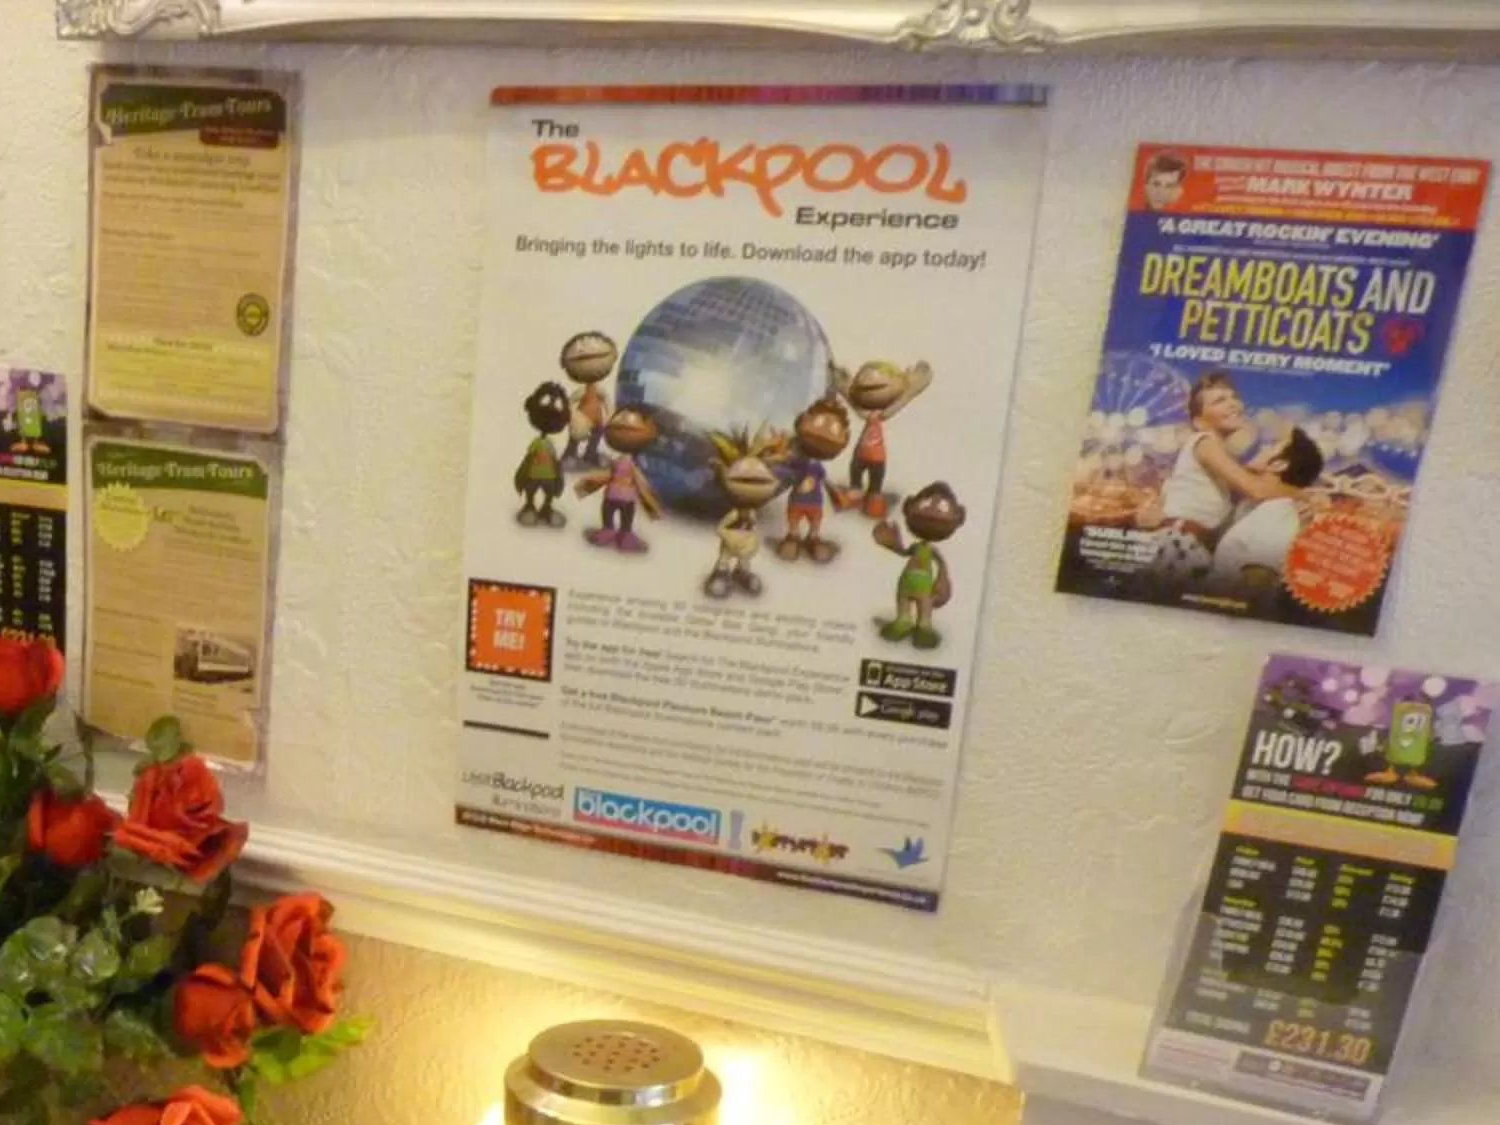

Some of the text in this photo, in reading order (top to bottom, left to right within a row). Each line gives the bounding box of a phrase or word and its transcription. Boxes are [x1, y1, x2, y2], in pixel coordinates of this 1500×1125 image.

[532, 119, 580, 140] The
[531, 137, 968, 217] BLACKPOOL
[1246, 176, 1311, 197] MARK
[1312, 181, 1414, 201] WYNTER
[794, 206, 960, 232] Experience
[1176, 219, 1248, 239] GREAT
[515, 235, 988, 271] Bringing the lights to life. Download the app today!
[1140, 253, 1360, 307] DREAMBOATS
[1359, 267, 1436, 314] AND
[1179, 297, 1375, 354] PETTICOATS
[1163, 344, 1226, 364] LOVED
[1228, 348, 1291, 370] EVERY
[495, 607, 528, 630] TRY
[493, 629, 525, 651] ME!
[884, 673, 911, 690] App
[1252, 729, 1343, 776] HOW?
[578, 790, 718, 835] blackpool
[1263, 1018, 1373, 1066] £231.30
